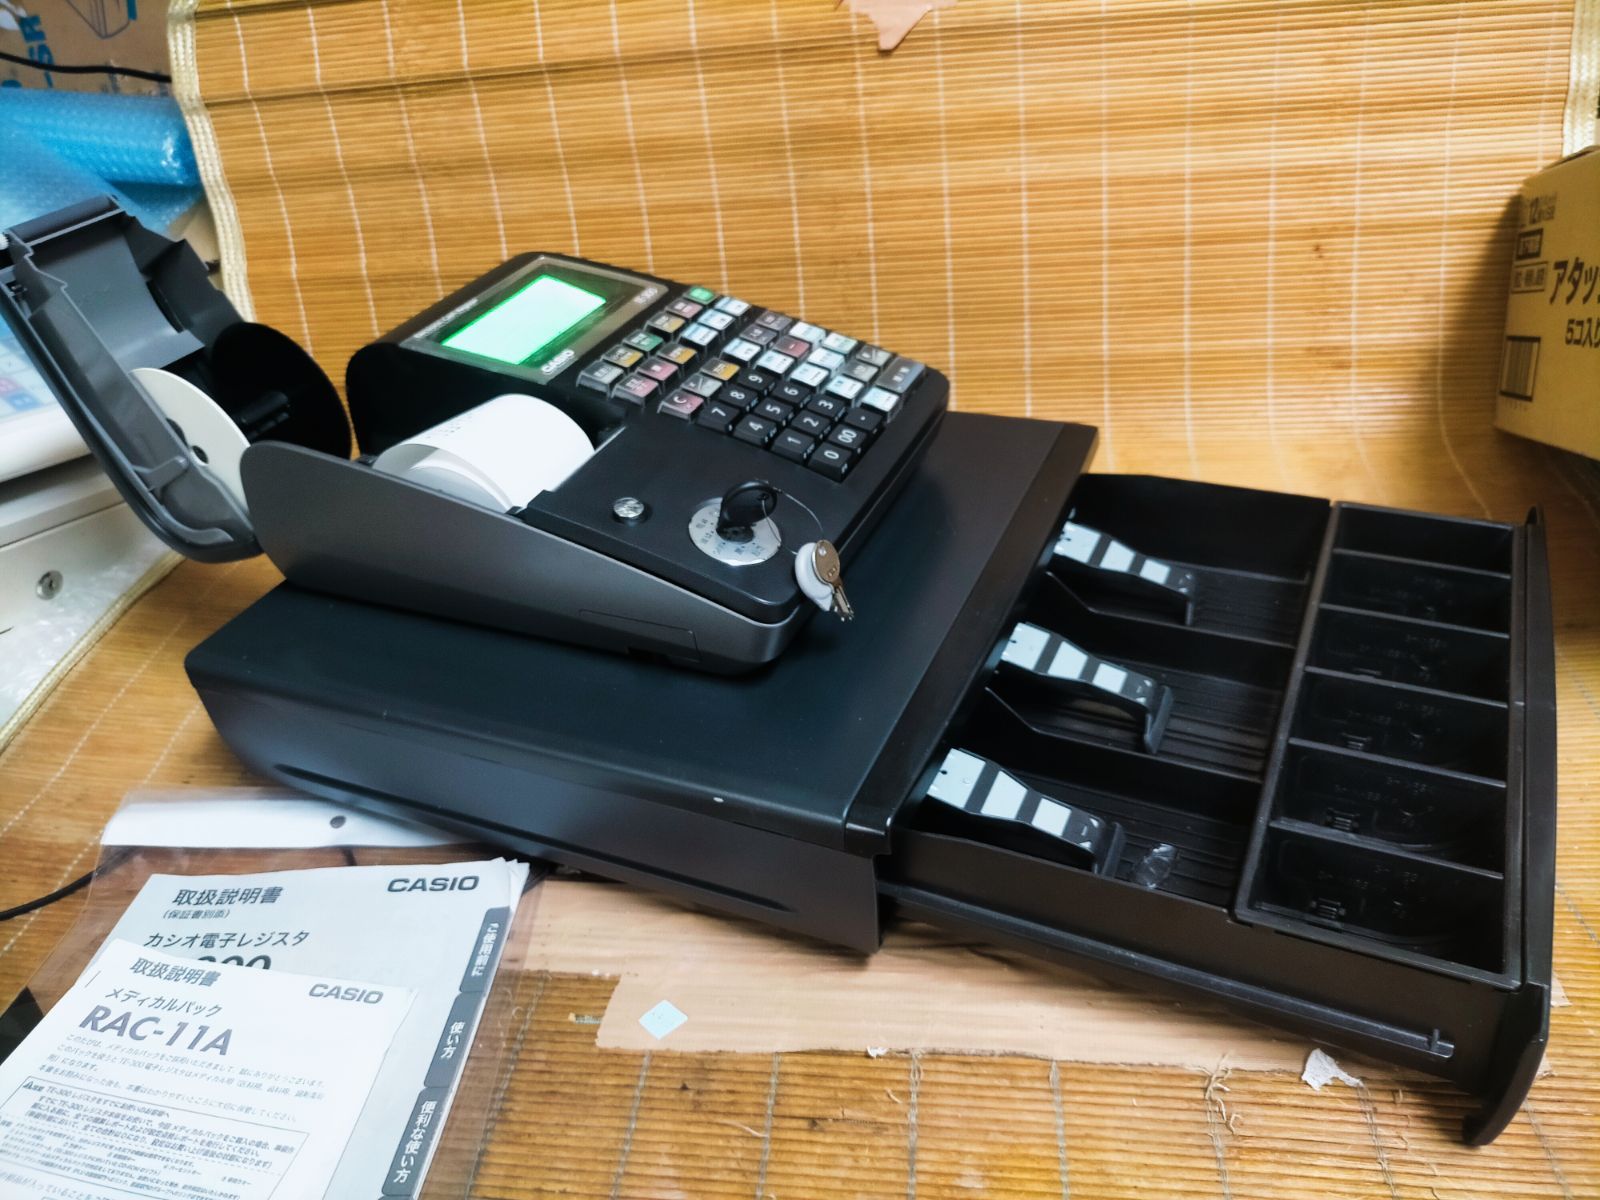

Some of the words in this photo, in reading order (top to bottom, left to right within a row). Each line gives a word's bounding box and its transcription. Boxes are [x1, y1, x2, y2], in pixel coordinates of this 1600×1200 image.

[1550, 257, 1600, 306] アタッ
[541, 348, 575, 374] CASIO
[748, 374, 763, 385] 9
[729, 389, 745, 401] 8
[786, 385, 801, 396] 6
[712, 404, 727, 418] 7
[768, 403, 783, 415] 5
[818, 399, 834, 410] 3
[751, 420, 764, 433] 4
[803, 416, 820, 429] 2
[787, 436, 801, 446] 1
[837, 428, 858, 444] 00
[824, 449, 839, 461] 0
[387, 875, 480, 893] CASIO
[172, 886, 284, 906] 取扱説明書
[143, 930, 310, 949] カシオ電子レジスタ
[471, 922, 501, 978] ご使用前に
[129, 957, 221, 988] 取扱説明書
[105, 987, 223, 1018] メディカルパック
[308, 983, 384, 1005] CASIO
[79, 1004, 233, 1056] RAC-11A
[440, 1021, 466, 1060] 使い方
[393, 1100, 438, 1184] 便利な使い方
